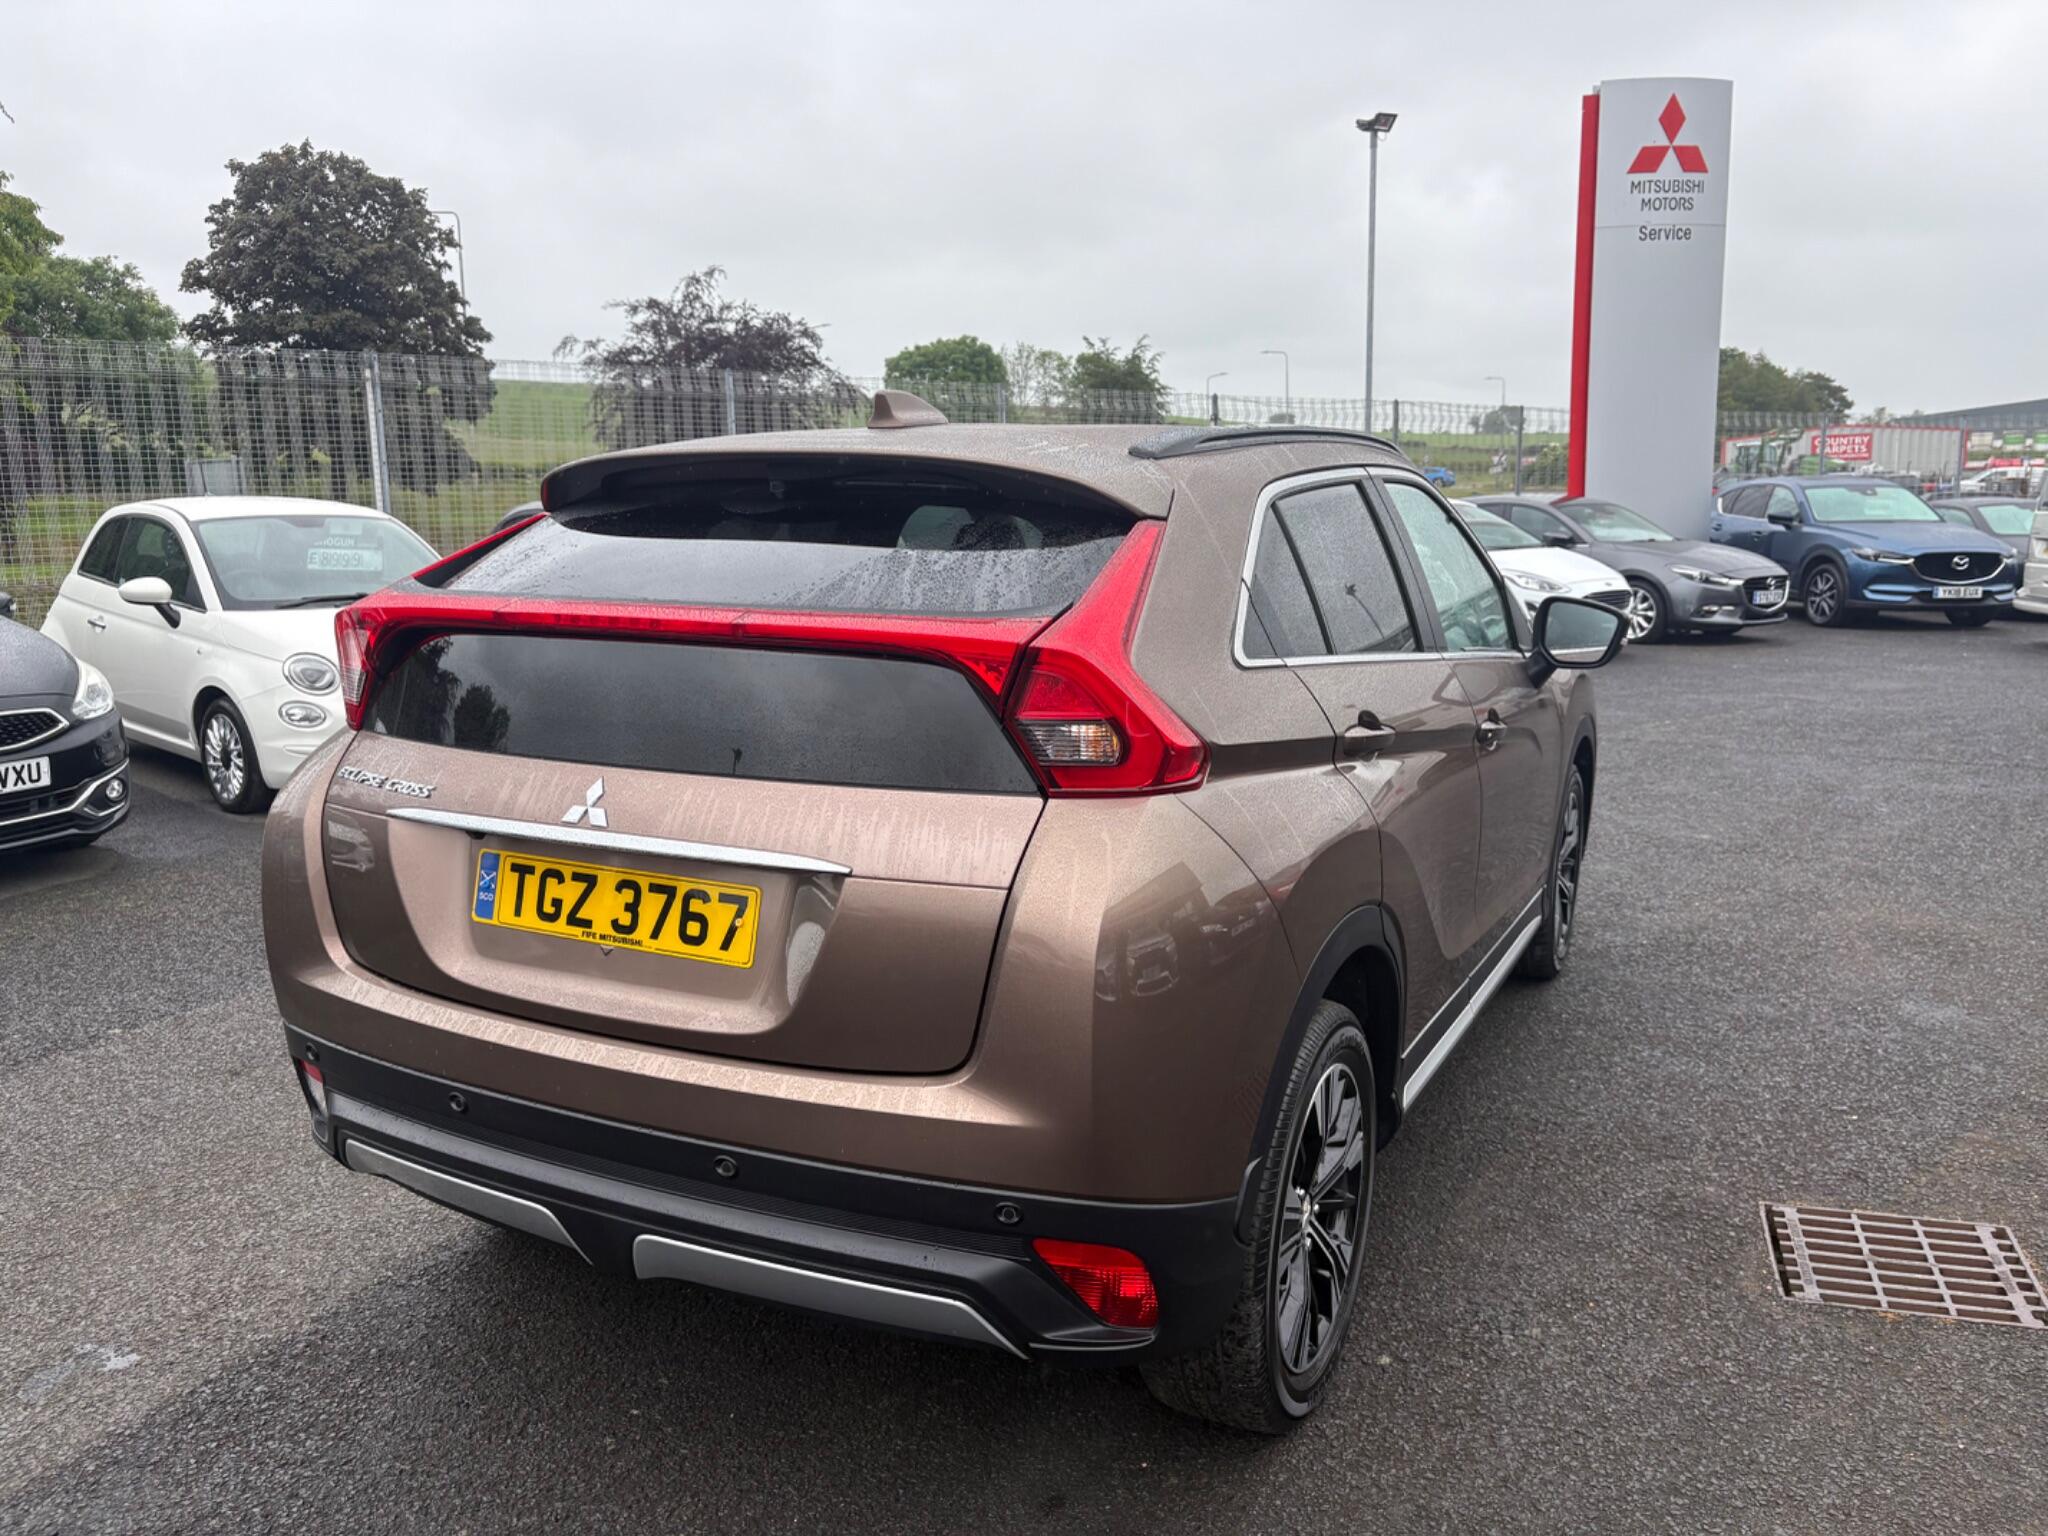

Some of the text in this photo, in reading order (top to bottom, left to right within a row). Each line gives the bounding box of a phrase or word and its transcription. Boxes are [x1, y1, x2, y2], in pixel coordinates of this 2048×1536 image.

[1630, 179, 1705, 194] MITSUBISHI
[1640, 197, 1695, 212] MOTORS
[1638, 224, 1692, 242] Service
[386, 779, 437, 798] CROSS
[510, 863, 749, 952] TGZ 3767
